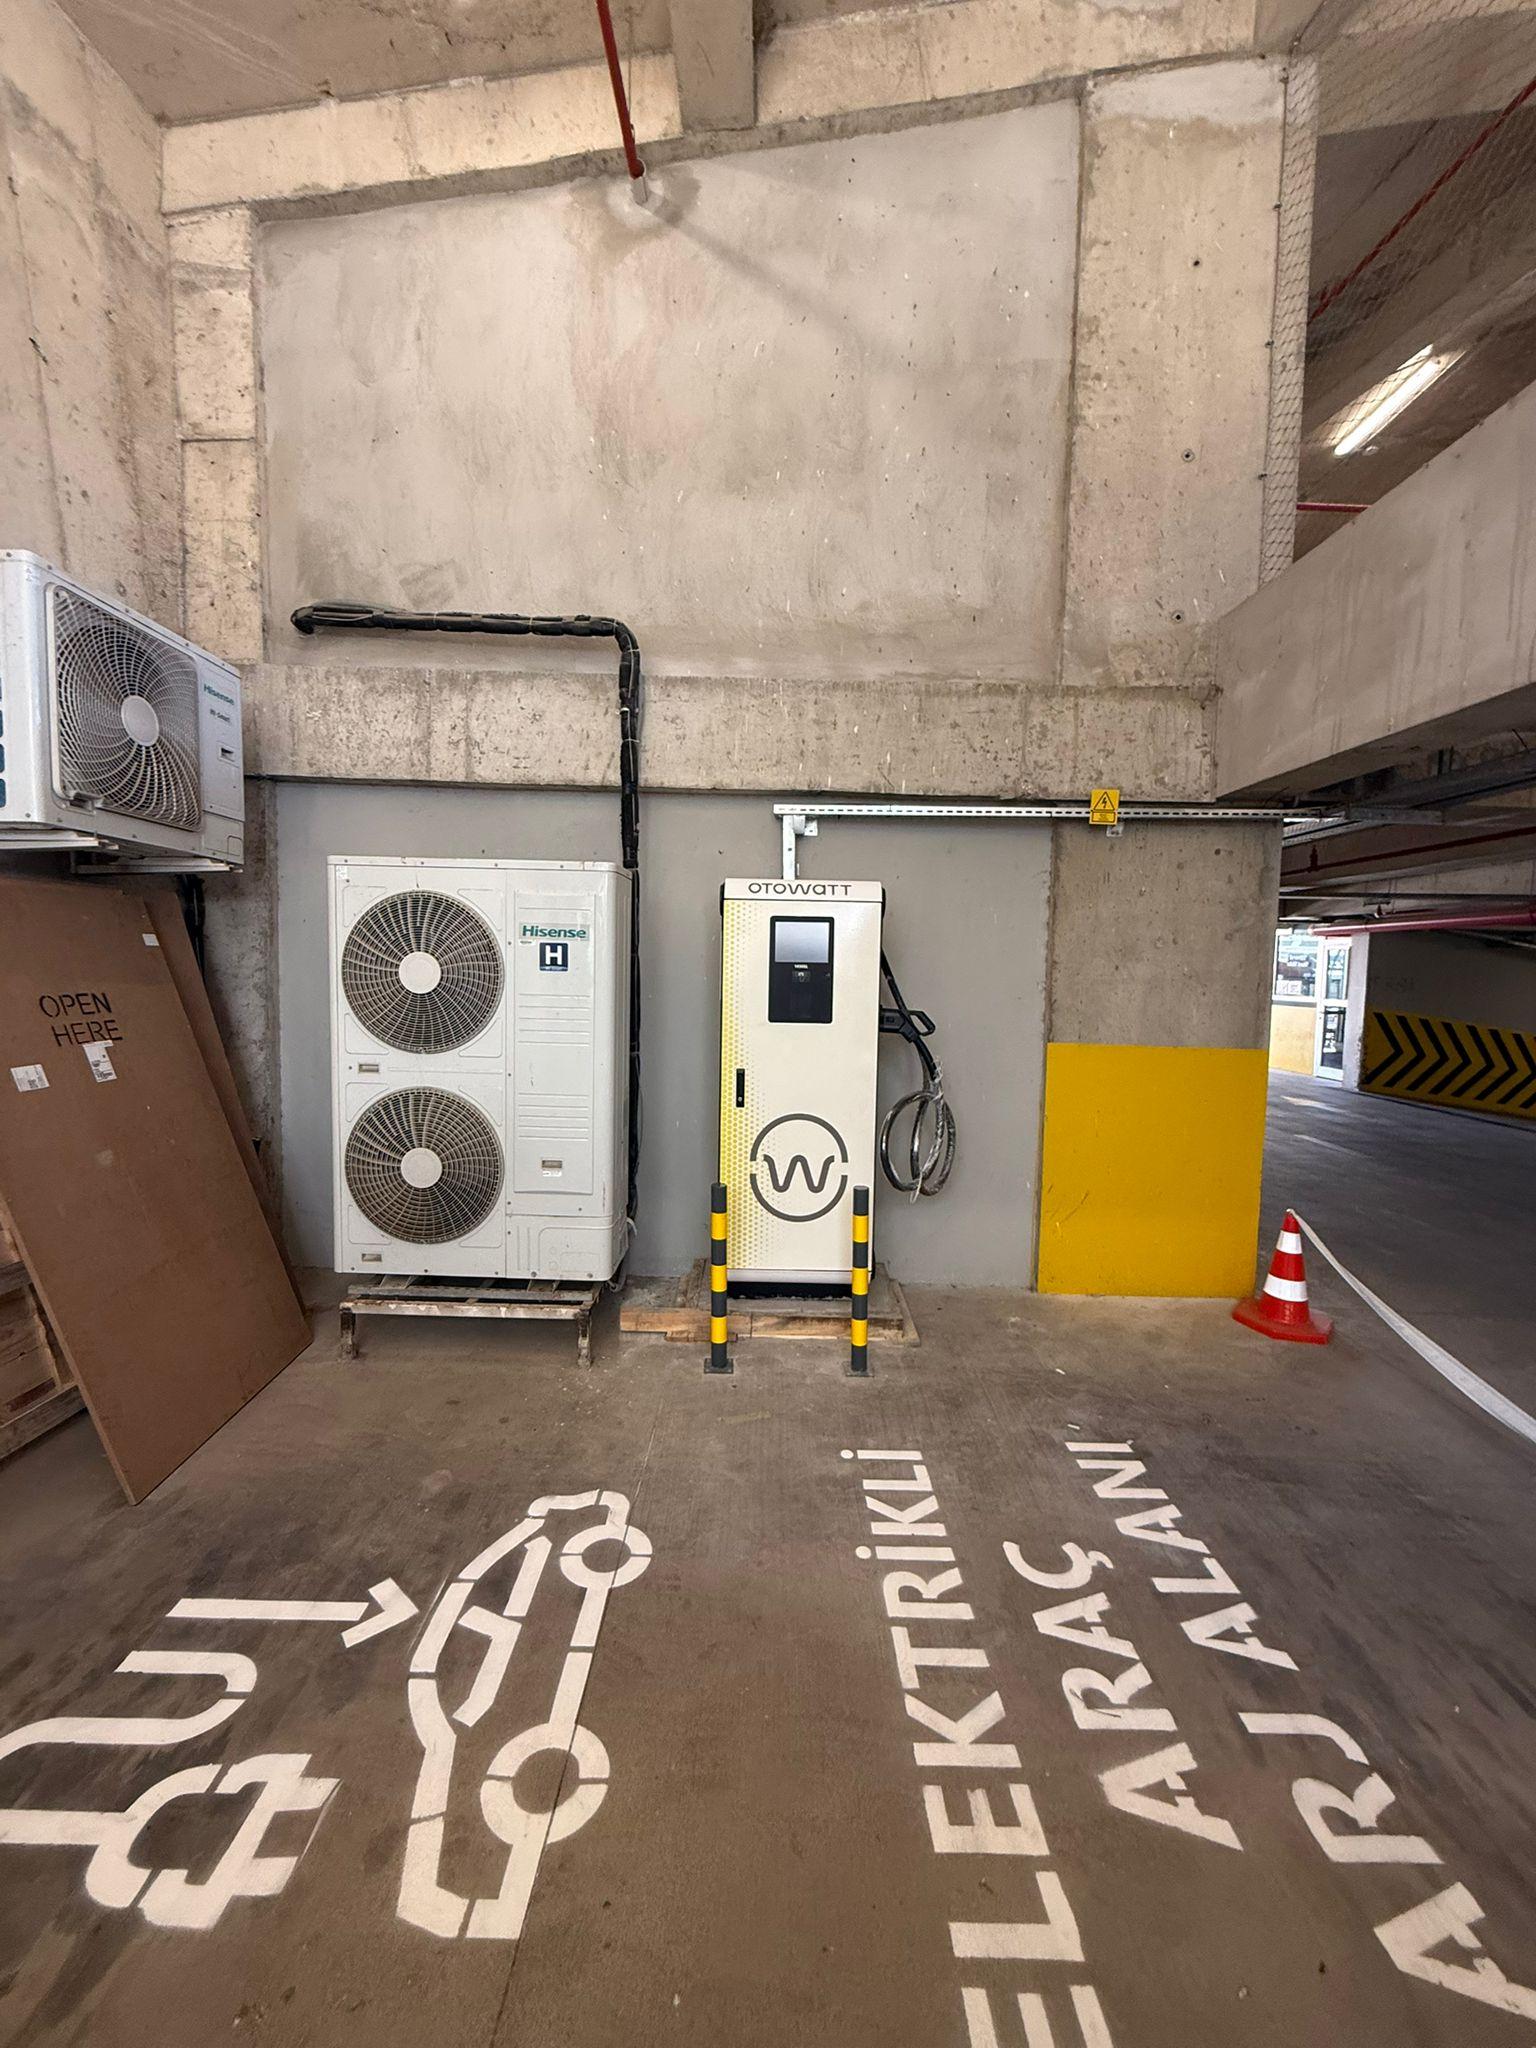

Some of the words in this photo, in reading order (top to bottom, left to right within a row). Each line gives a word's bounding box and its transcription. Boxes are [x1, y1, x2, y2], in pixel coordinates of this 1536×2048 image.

[522, 925, 587, 939] Hisense
[544, 944, 563, 966] H
[39, 993, 113, 1018] OPEN
[51, 1019, 124, 1047] HERE
[1065, 1441, 1300, 1671] ALANI
[1003, 1541, 1243, 1851] ARAÇ
